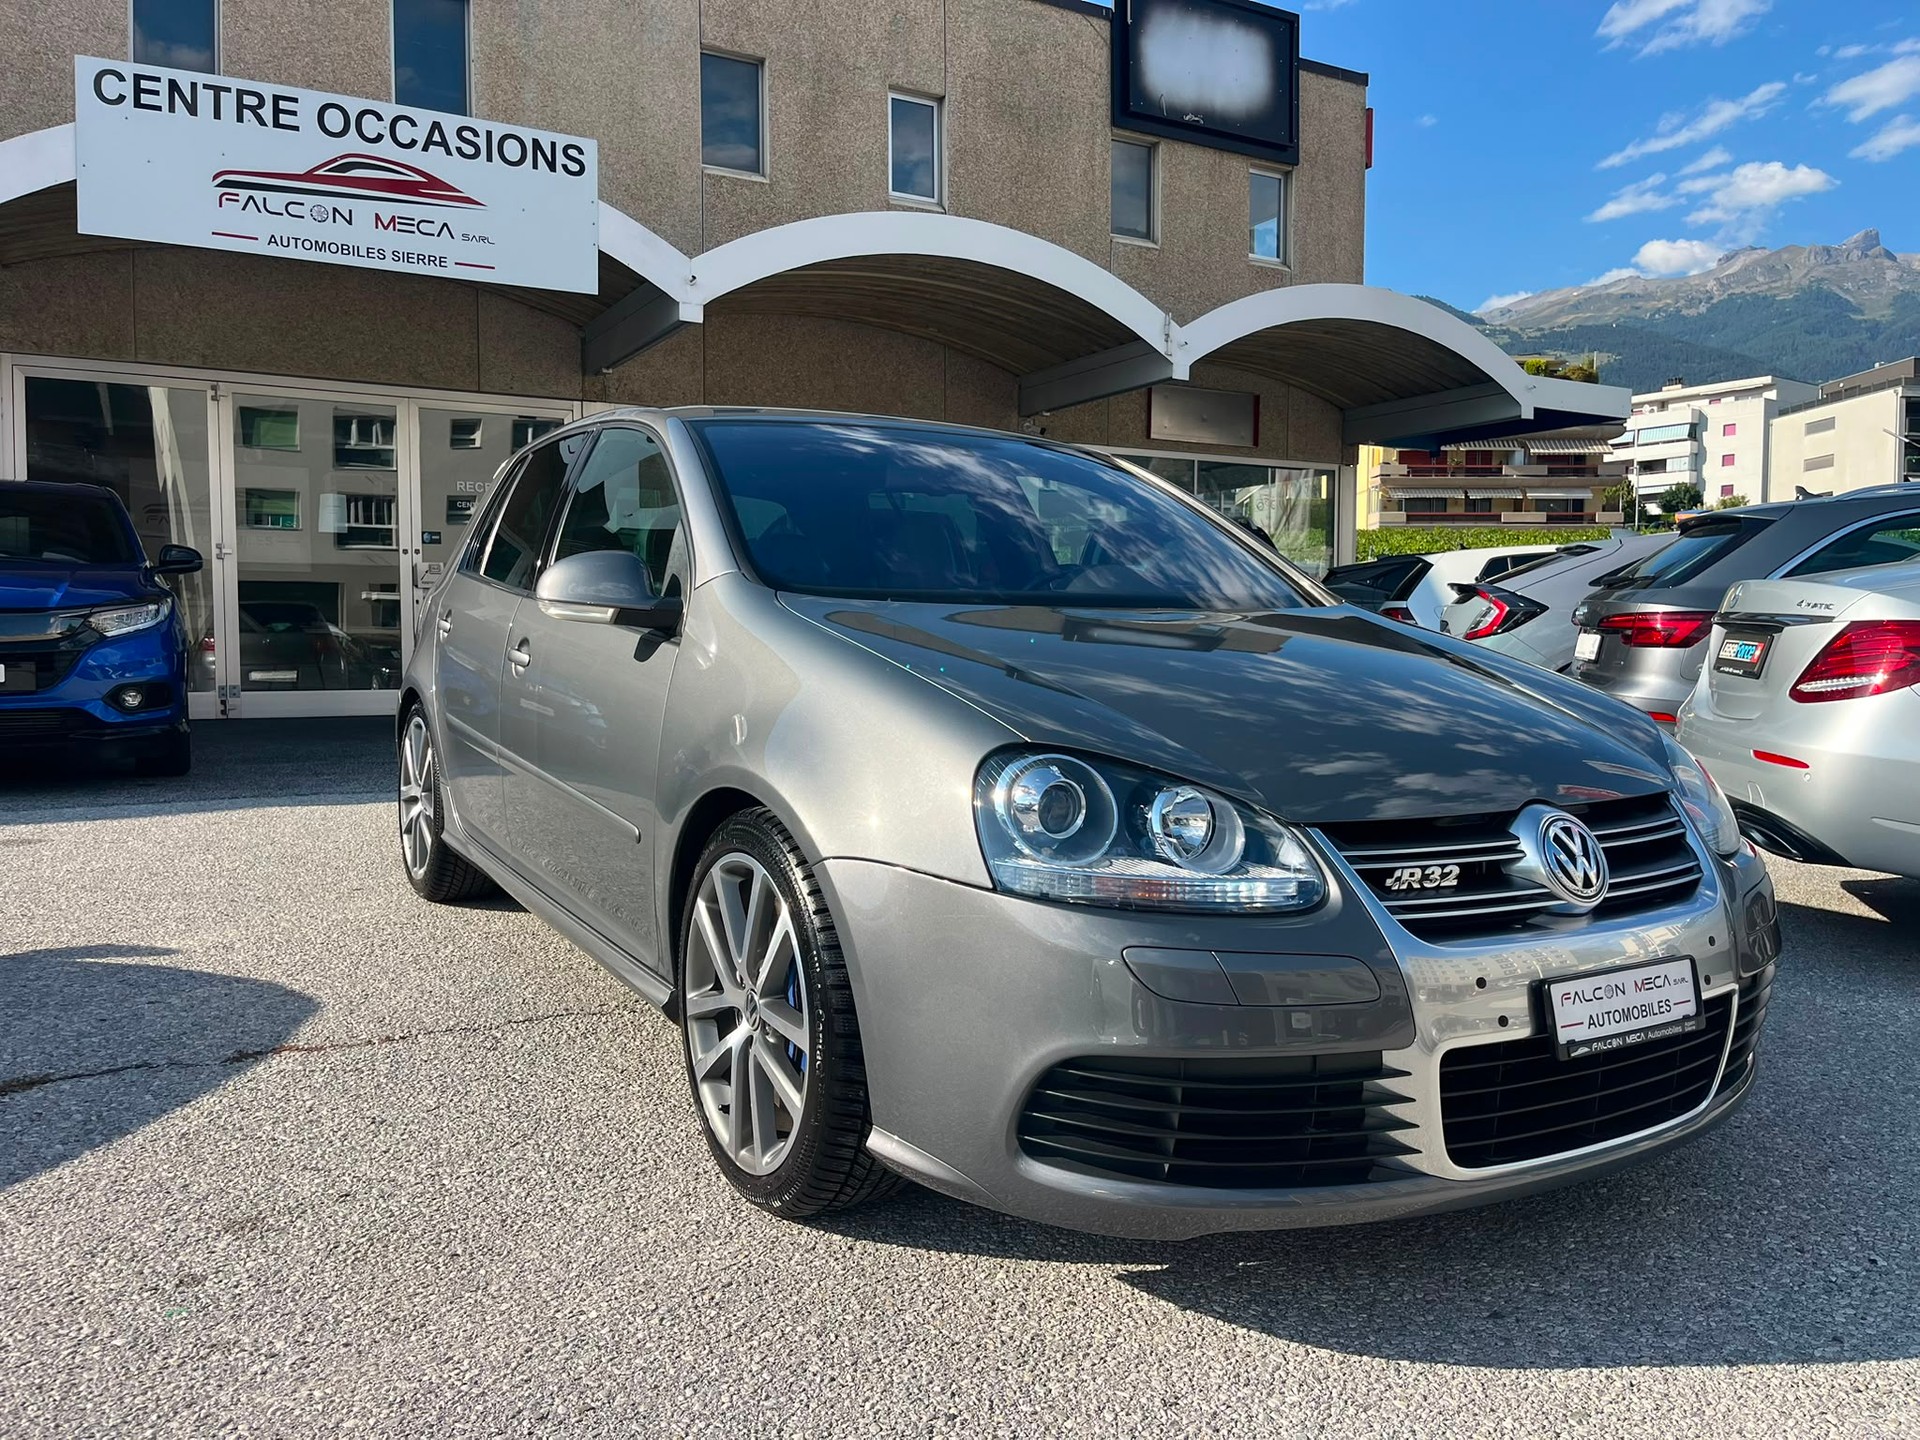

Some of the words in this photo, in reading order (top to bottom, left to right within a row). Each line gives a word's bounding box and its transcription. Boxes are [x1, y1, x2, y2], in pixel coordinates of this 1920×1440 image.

[93, 68, 300, 132] CENTRE
[316, 102, 587, 177] OCCASIONS
[218, 191, 353, 226] FALCON
[374, 212, 455, 240] MECA
[461, 232, 496, 245] SARL
[266, 234, 387, 261] AUTOMOBILES
[391, 250, 449, 268] SIERRE
[1397, 864, 1460, 890] R32
[1560, 982, 1626, 1007] FALCON
[1634, 974, 1672, 993] MECA
[1587, 998, 1672, 1030] AUTOMOBILES
[1592, 1037, 1623, 1052] FALCON
[1626, 1032, 1646, 1044] MECA
[1647, 1025, 1682, 1039] Automobiles
